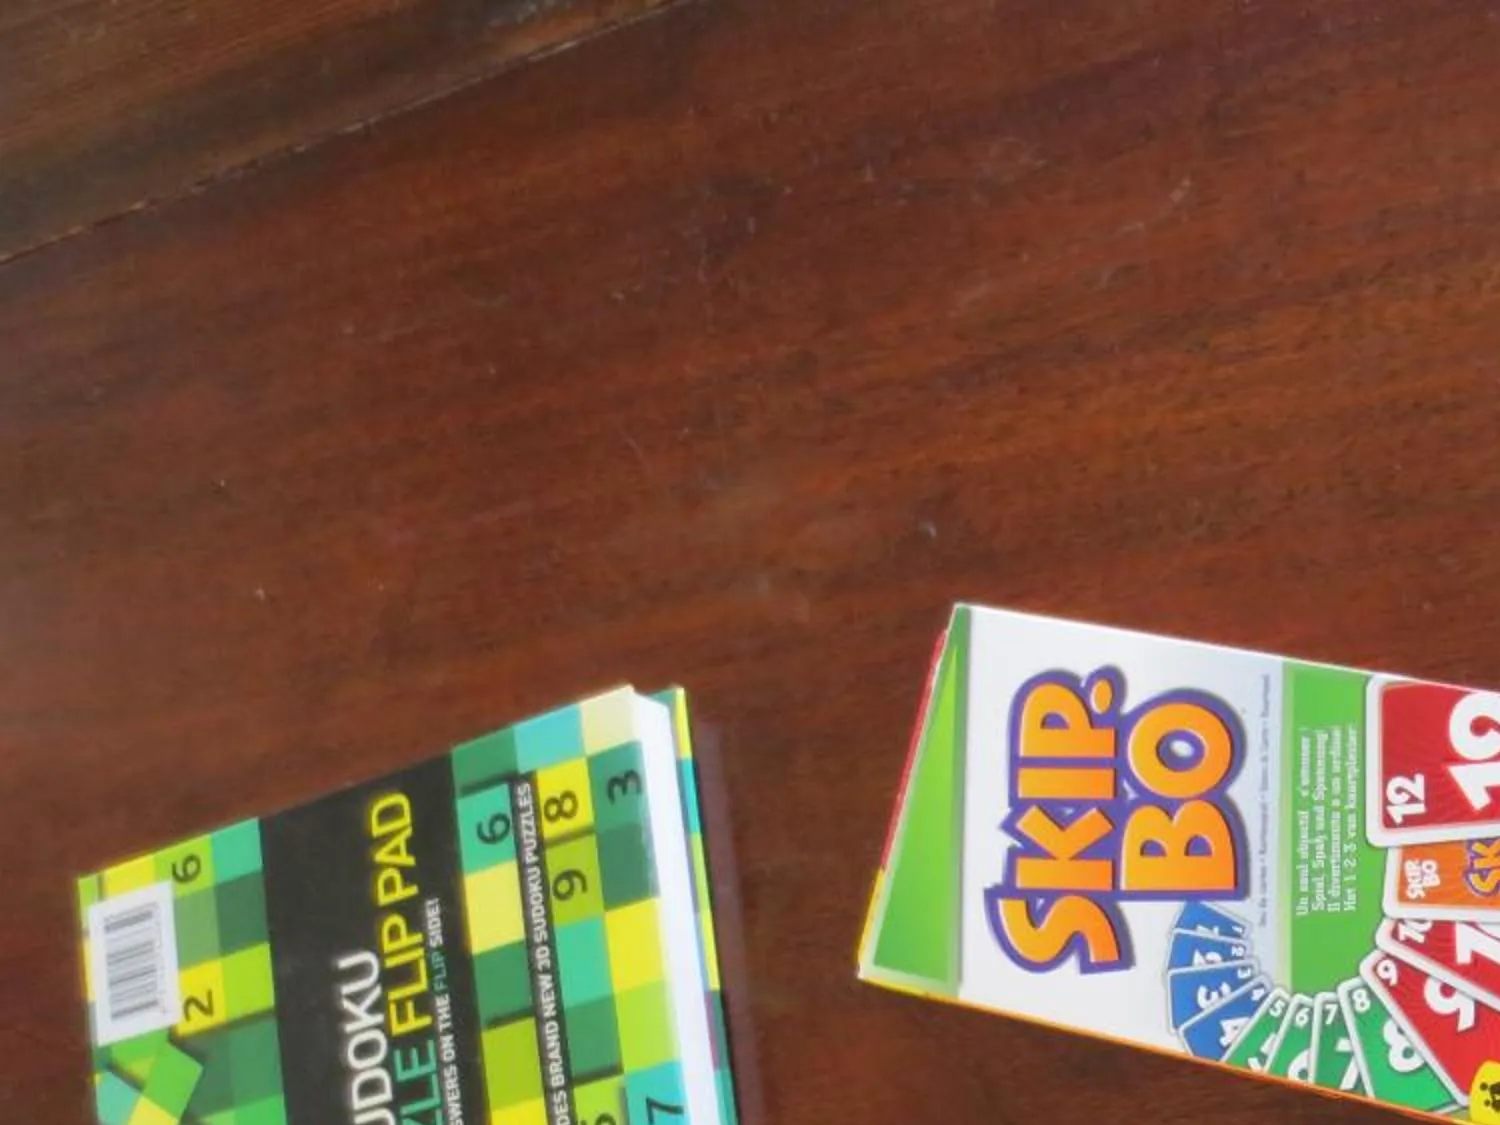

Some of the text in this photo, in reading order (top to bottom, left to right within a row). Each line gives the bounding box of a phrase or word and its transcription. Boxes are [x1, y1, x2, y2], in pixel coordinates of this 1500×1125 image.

[606, 769, 642, 804] 3
[1118, 695, 1243, 895] BO
[1386, 774, 1426, 824] 12
[514, 781, 538, 864] PUZZLES
[544, 788, 580, 823] 8
[476, 811, 512, 845] 6
[365, 787, 420, 907] PAD
[172, 852, 201, 884] 6
[555, 868, 588, 902] 9
[424, 896, 443, 948] SIDE!
[524, 866, 548, 943] SUDOKU
[377, 904, 434, 1037] FLIP
[430, 948, 448, 992] FLIP
[534, 944, 552, 970] 3D
[1377, 960, 1397, 986] 9
[183, 989, 215, 1022] 2
[435, 992, 452, 1030] THE
[537, 971, 557, 1017] NEW
[1269, 1000, 1285, 1017] 5
[1353, 989, 1371, 1012] 8
[1295, 1007, 1309, 1027] 6
[1325, 1005, 1338, 1025] 7
[440, 1032, 456, 1062] ON
[543, 1018, 566, 1088] BRAND
